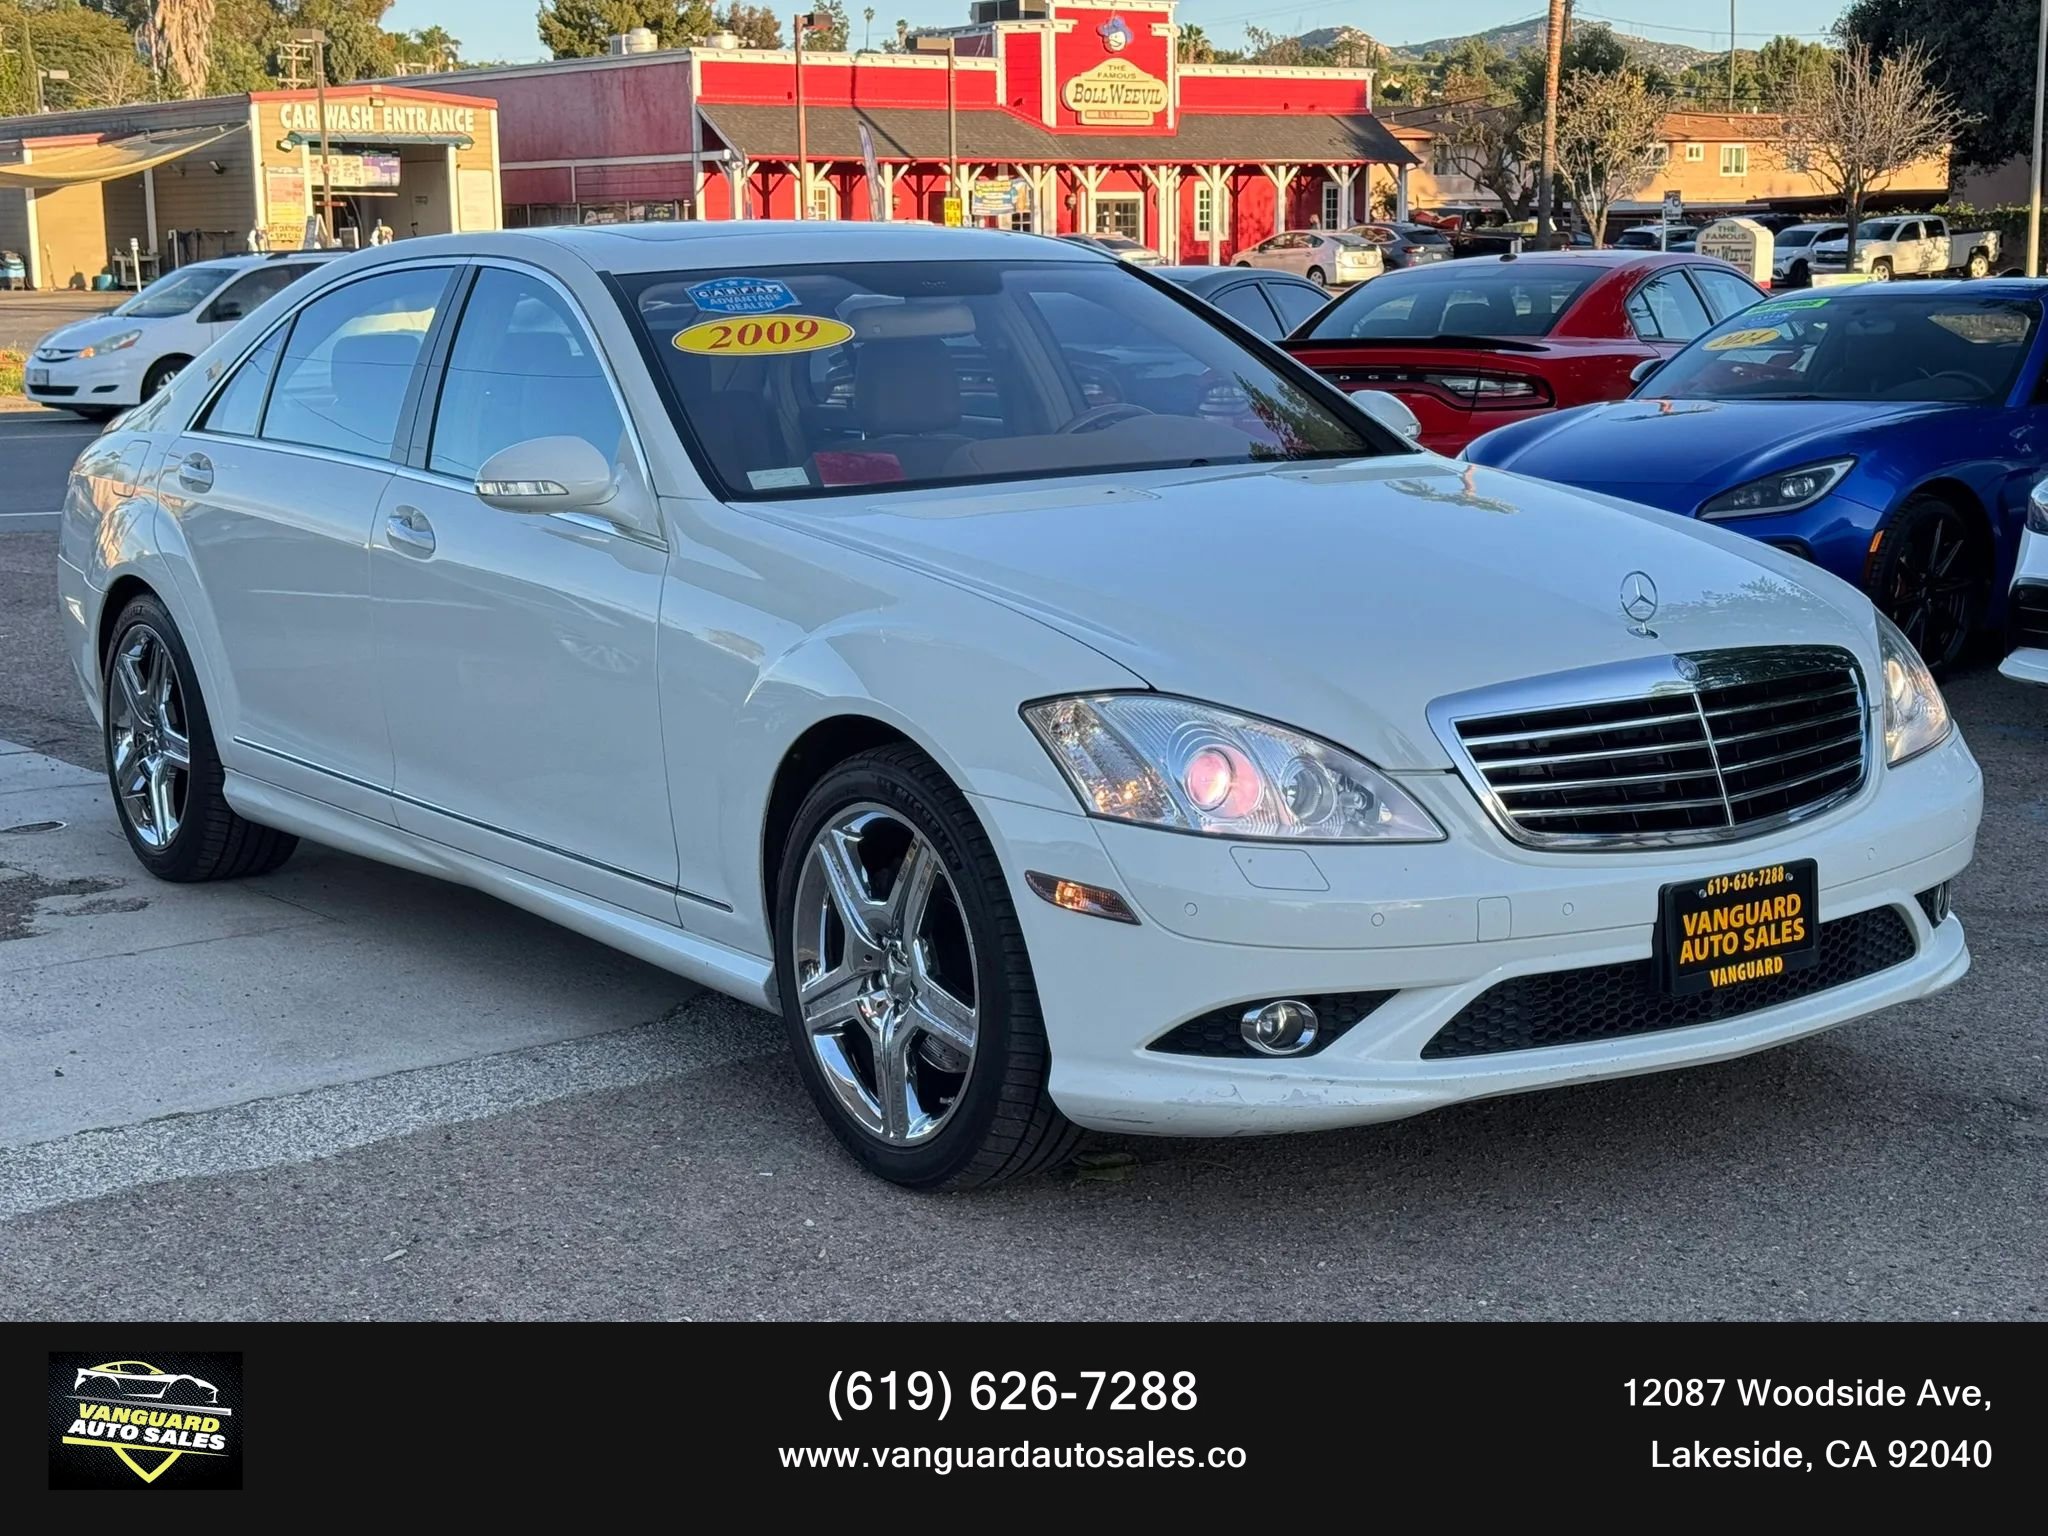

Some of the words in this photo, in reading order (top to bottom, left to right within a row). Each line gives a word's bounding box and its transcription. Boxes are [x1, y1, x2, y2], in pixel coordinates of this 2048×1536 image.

[1072, 83, 1108, 104] BOLL
[1110, 84, 1163, 105] WEEVIL
[279, 104, 319, 129] CAR
[324, 104, 374, 130] WASH
[383, 105, 475, 132] ENTRANCE
[697, 284, 783, 298] CARFAX
[709, 293, 783, 306] ADVANTAGE
[726, 301, 774, 312] DEALER
[708, 319, 820, 350] 2009
[1682, 893, 1801, 937] VANGUARD
[1680, 931, 1739, 965] AUTO
[1743, 917, 1805, 952] SALES
[1710, 956, 1784, 988] VANGUARD
